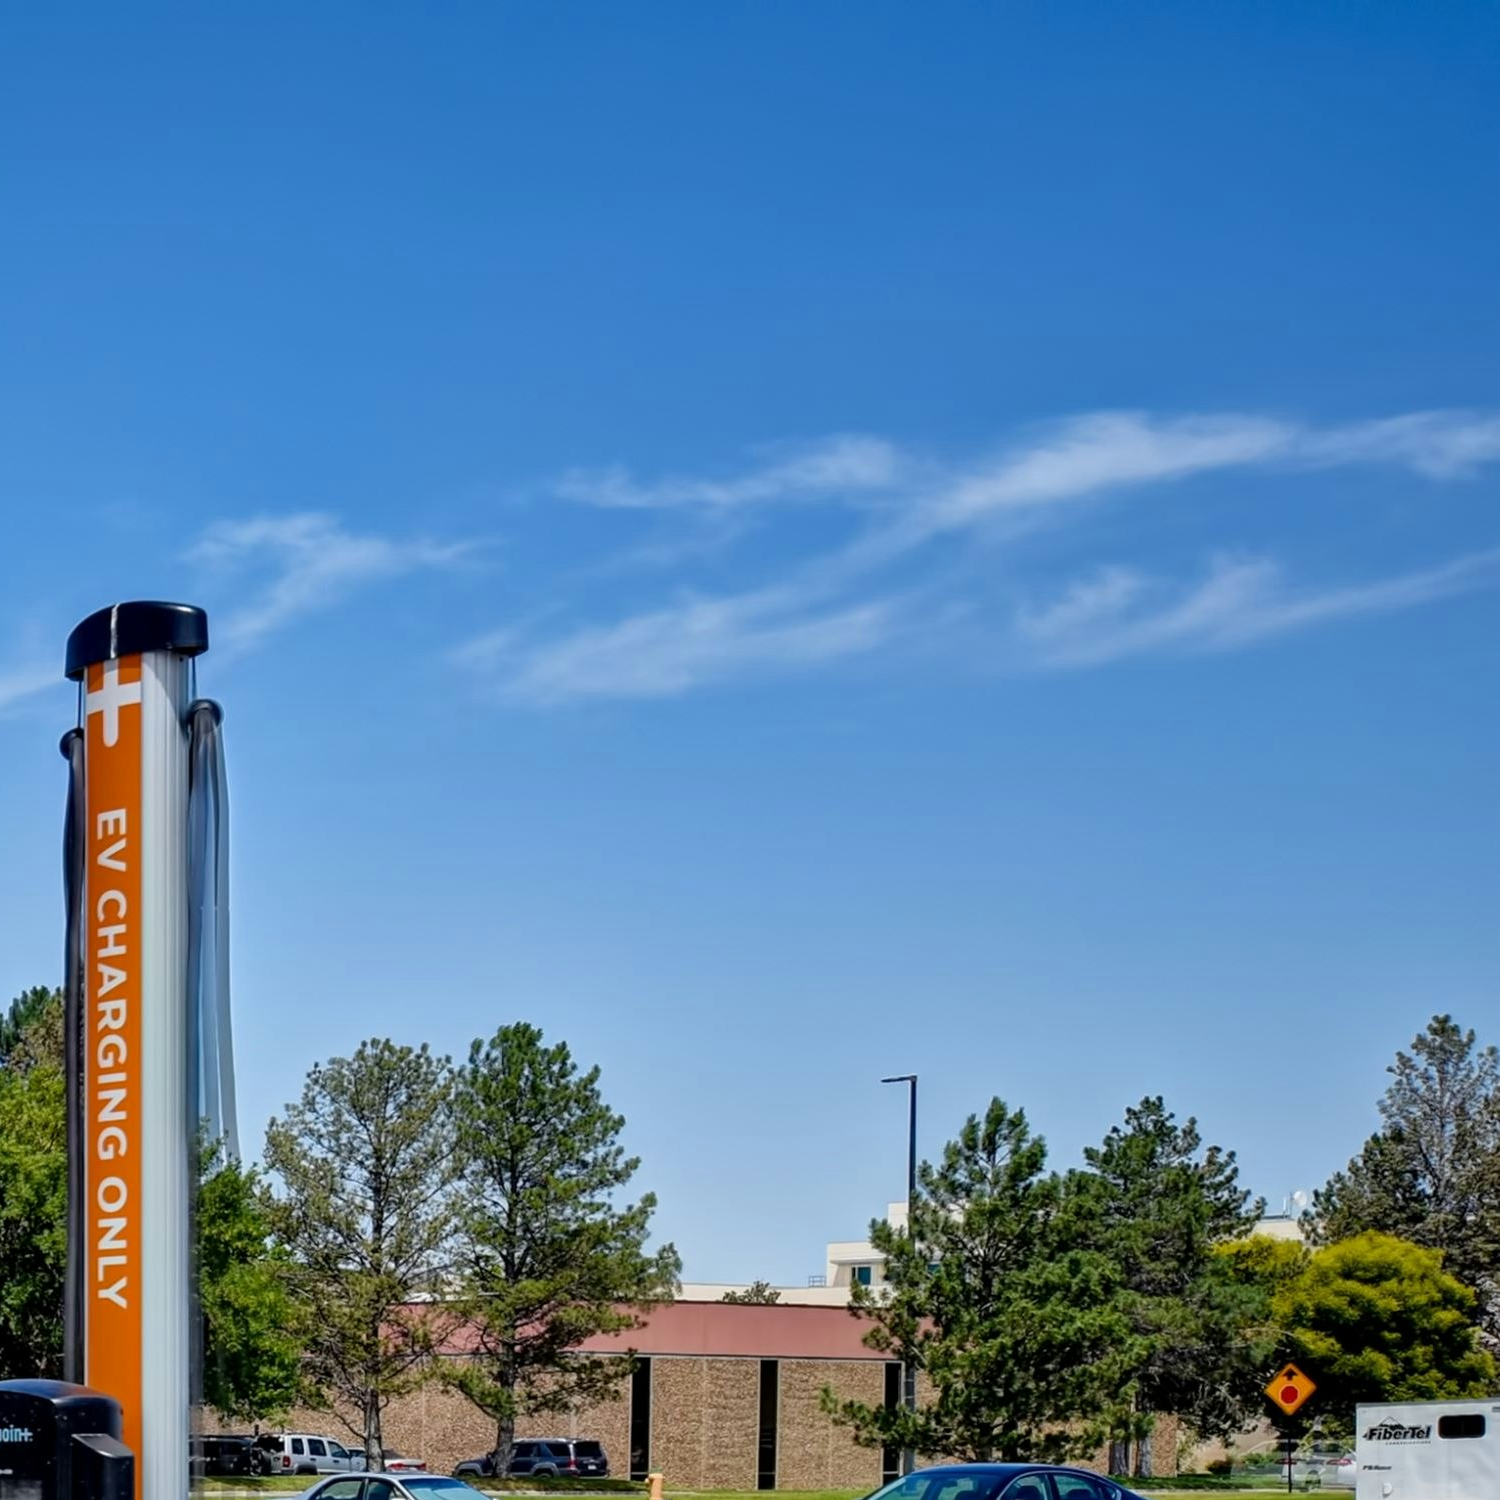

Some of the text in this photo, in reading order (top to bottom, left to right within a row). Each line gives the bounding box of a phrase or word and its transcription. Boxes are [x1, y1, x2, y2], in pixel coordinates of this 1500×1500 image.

[96, 807, 128, 1309] EV CHARGING ONLY
[1367, 1424, 1432, 1441] FiberTel
